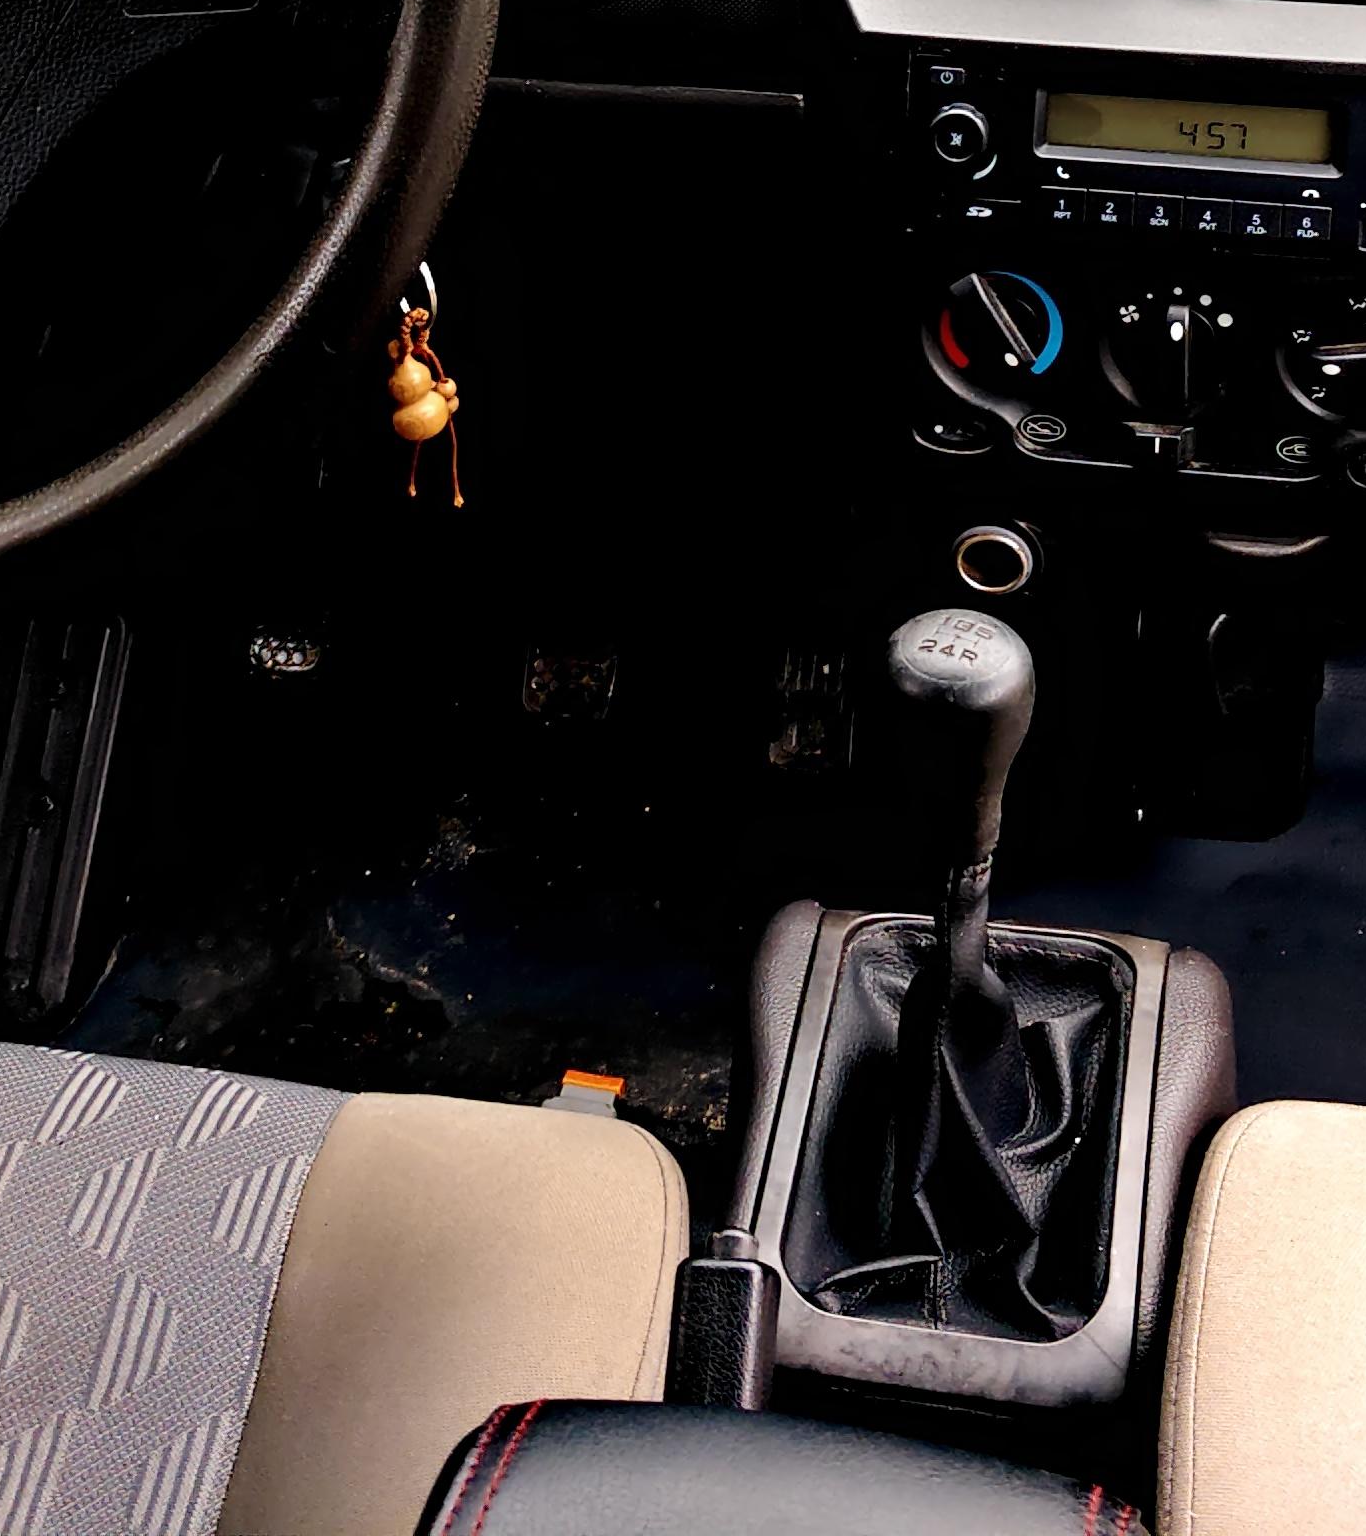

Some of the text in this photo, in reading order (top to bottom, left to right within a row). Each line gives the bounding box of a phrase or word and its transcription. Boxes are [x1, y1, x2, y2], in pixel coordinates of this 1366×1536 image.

[1058, 199, 1065, 210] 1
[1105, 201, 1115, 214] 2
[1053, 210, 1072, 220] RPT
[1155, 205, 1164, 218] 3
[1202, 210, 1212, 221] 4
[1149, 217, 1170, 227] SCN
[1251, 214, 1261, 225] 5
[1302, 216, 1312, 229] 6
